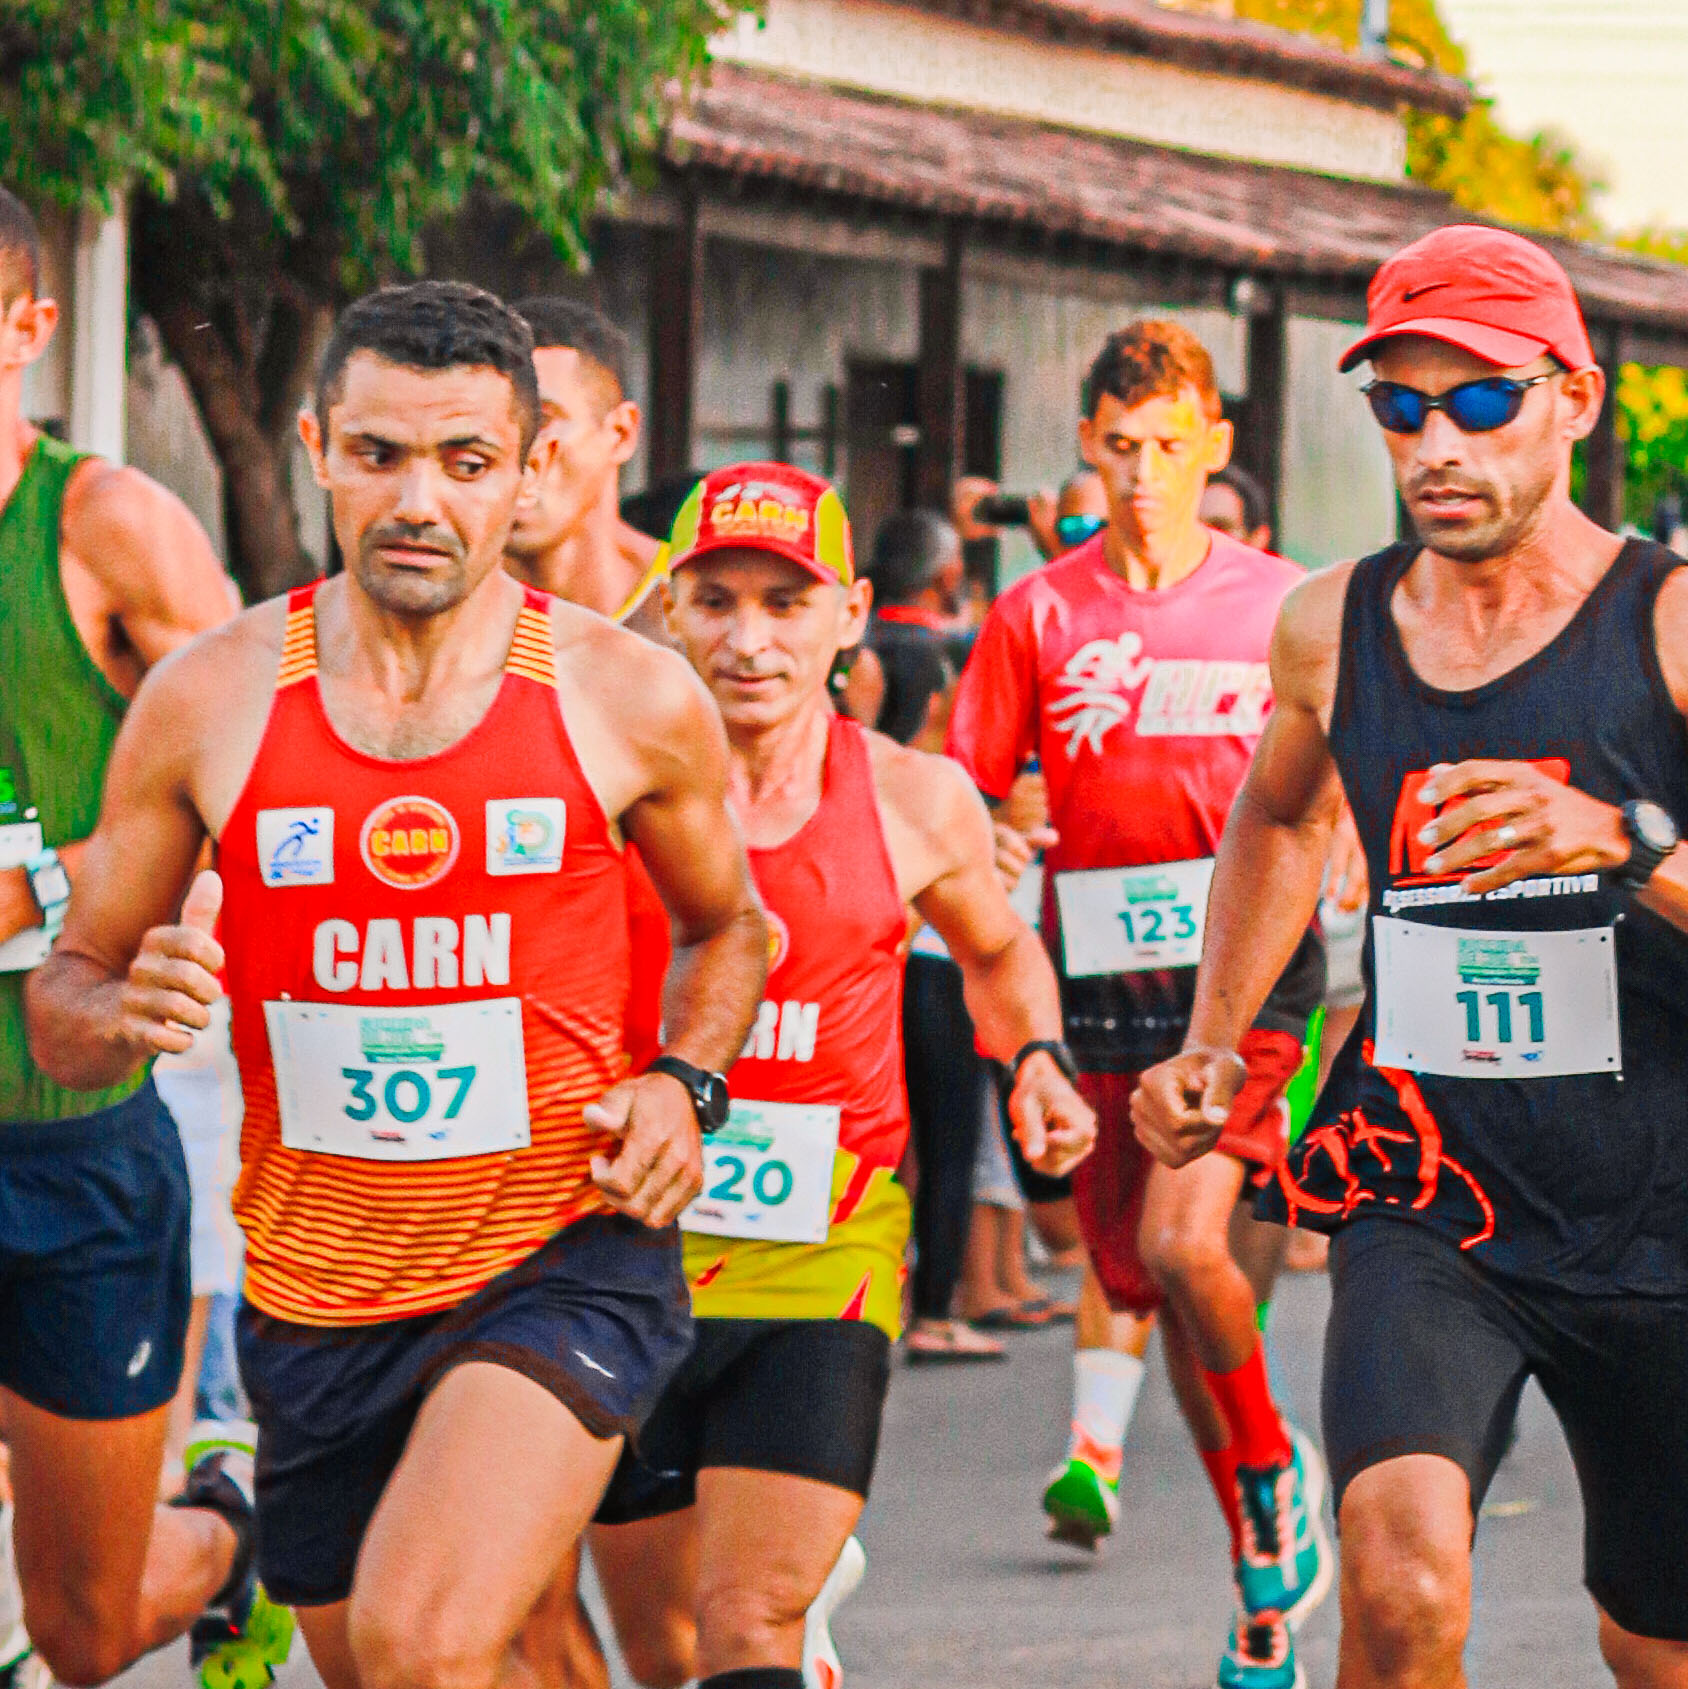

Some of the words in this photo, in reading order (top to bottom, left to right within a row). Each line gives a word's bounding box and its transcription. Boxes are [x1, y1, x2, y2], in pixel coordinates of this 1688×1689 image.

[371, 827, 449, 858] CARN
[1117, 905, 1197, 943] 123
[312, 912, 511, 993] CARN
[740, 1000, 820, 1063] RN
[1456, 990, 1544, 1043] 111
[341, 1065, 477, 1123] 307
